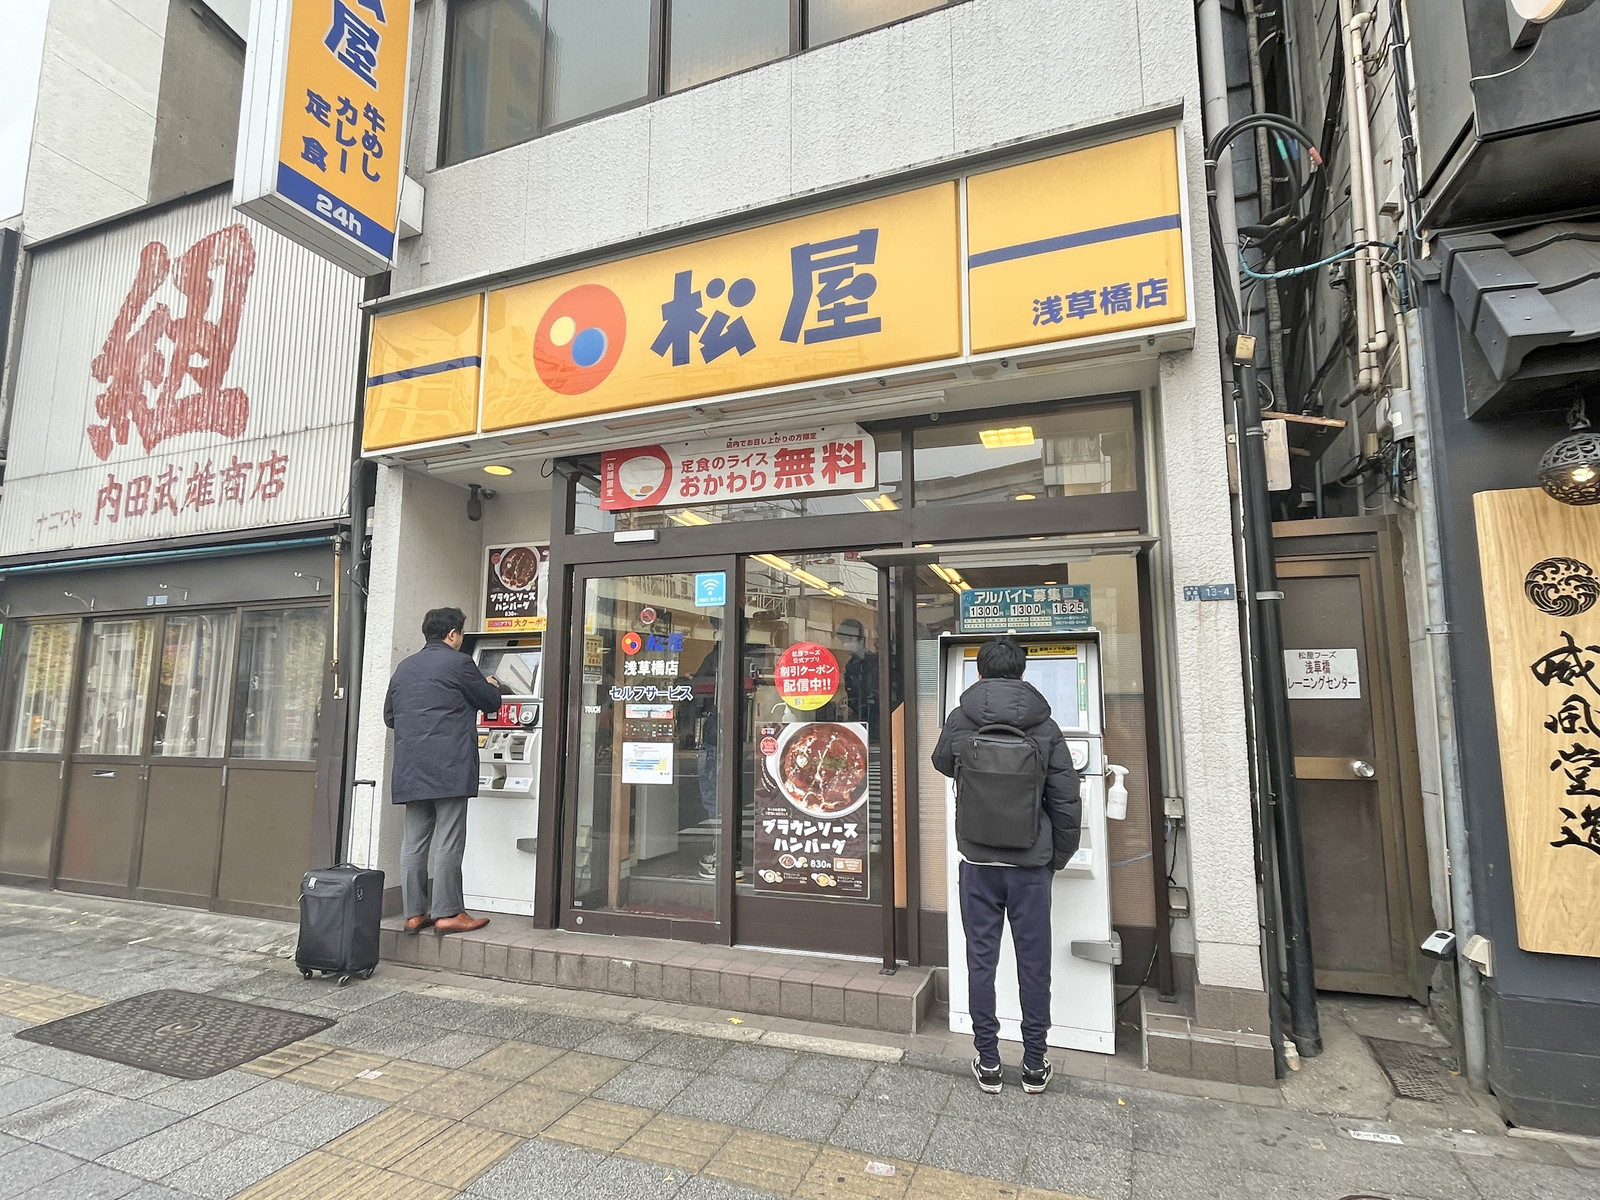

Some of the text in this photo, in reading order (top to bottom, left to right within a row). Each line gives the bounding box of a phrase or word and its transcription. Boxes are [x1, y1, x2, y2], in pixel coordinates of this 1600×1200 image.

[323, 0, 389, 90] 屋
[300, 88, 332, 173] 定食
[335, 96, 358, 174] カレー
[362, 102, 386, 182] 牛めし
[315, 193, 362, 236] 24h
[650, 228, 882, 366] 松屋
[1032, 277, 1169, 327] 浅草橋店
[679, 439, 866, 498] おかわり 無料
[680, 452, 769, 474] 定食のライス
[94, 450, 289, 525] 内田武雄商店
[974, 587, 1061, 604] アルバイト募集
[1205, 587, 1230, 597] 13-4
[646, 632, 684, 652] 松屋
[1298, 650, 1337, 660] 松屋フーズ
[624, 660, 680, 676] 浅草橋店
[780, 663, 835, 677] 割引クーポン
[1305, 660, 1331, 674] 浅草橋
[609, 685, 694, 701] セルフサービス
[762, 819, 858, 839] ブラウンソース
[773, 836, 846, 855] ハンバーグ
